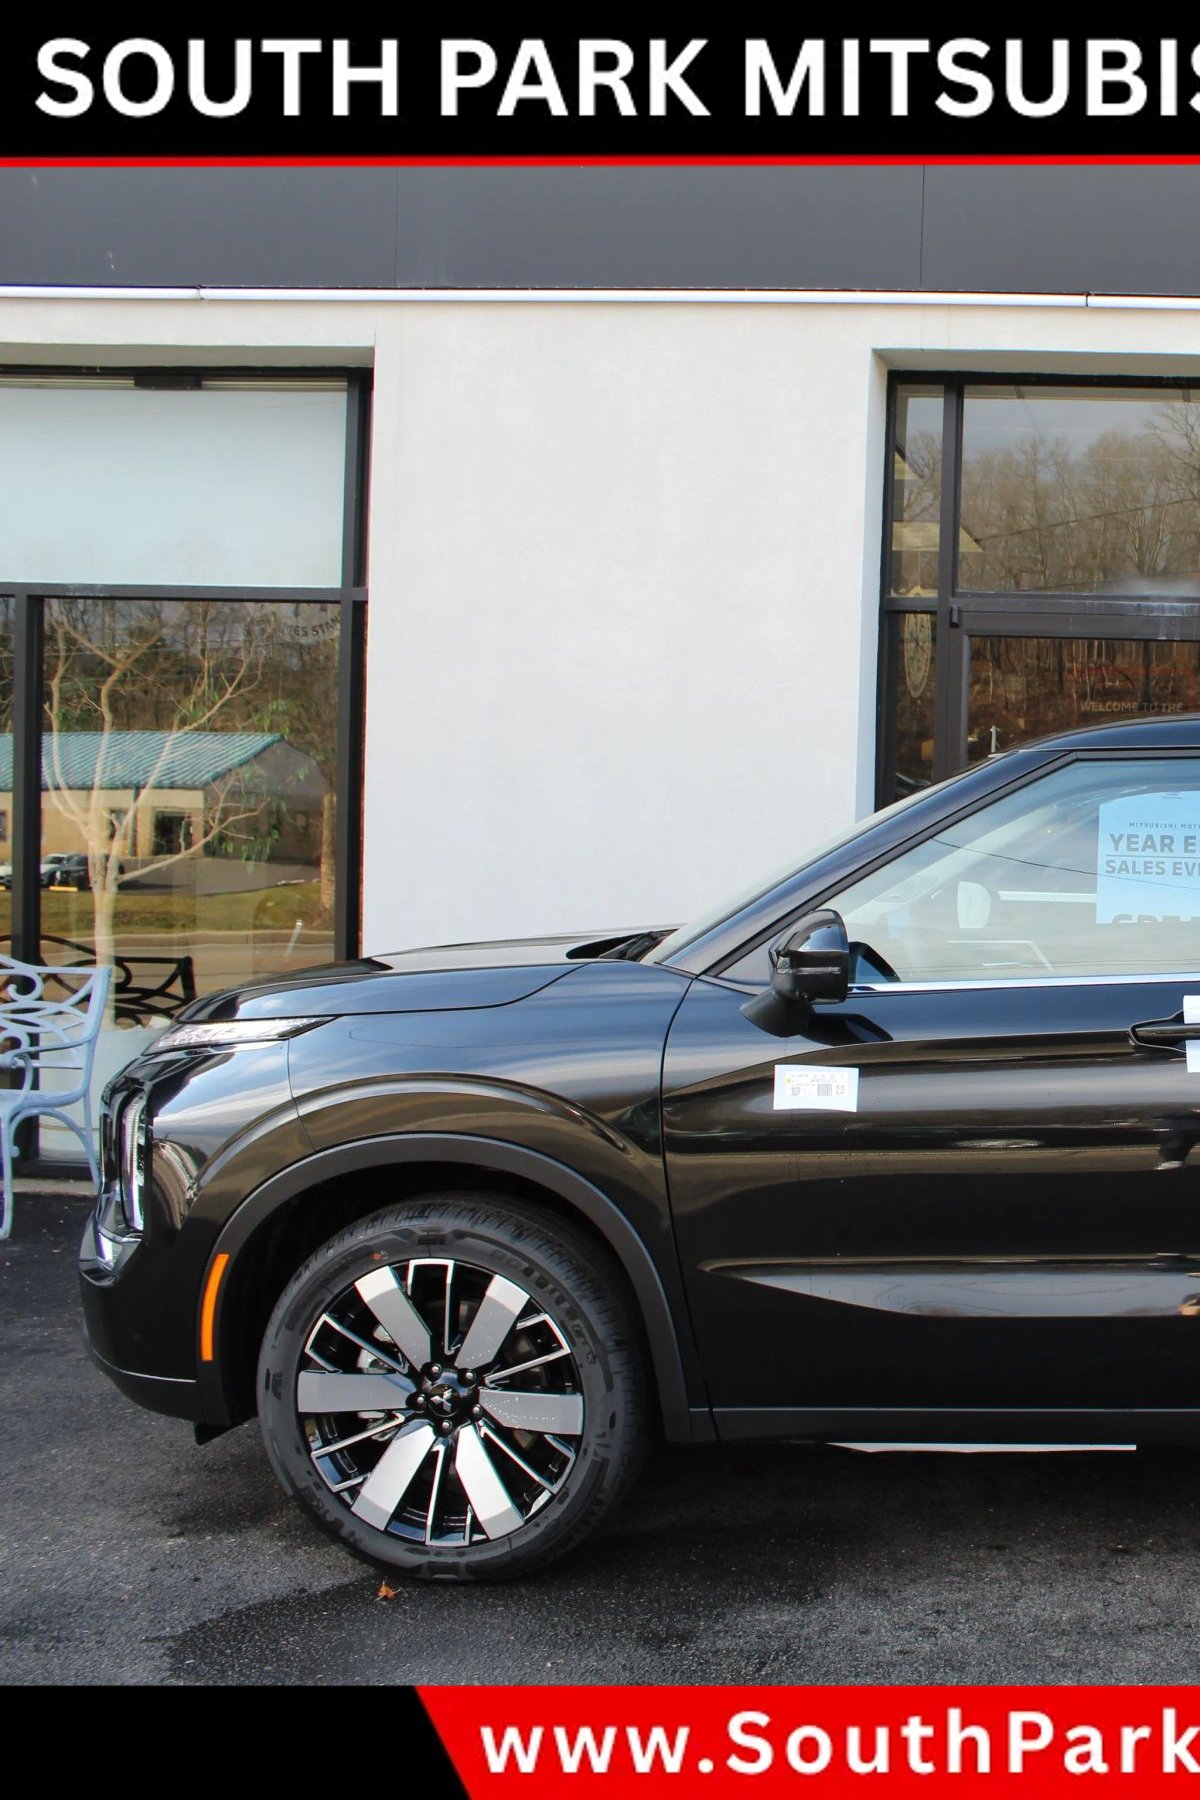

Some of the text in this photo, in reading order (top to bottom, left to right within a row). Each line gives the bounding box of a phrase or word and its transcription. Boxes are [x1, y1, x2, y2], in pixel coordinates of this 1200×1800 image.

[1080, 700, 1184, 713] WELCOME TO THE
[1128, 821, 1178, 829] MITSUBISHI
[1108, 832, 1176, 853] YEAR
[1105, 859, 1167, 876] SALES
